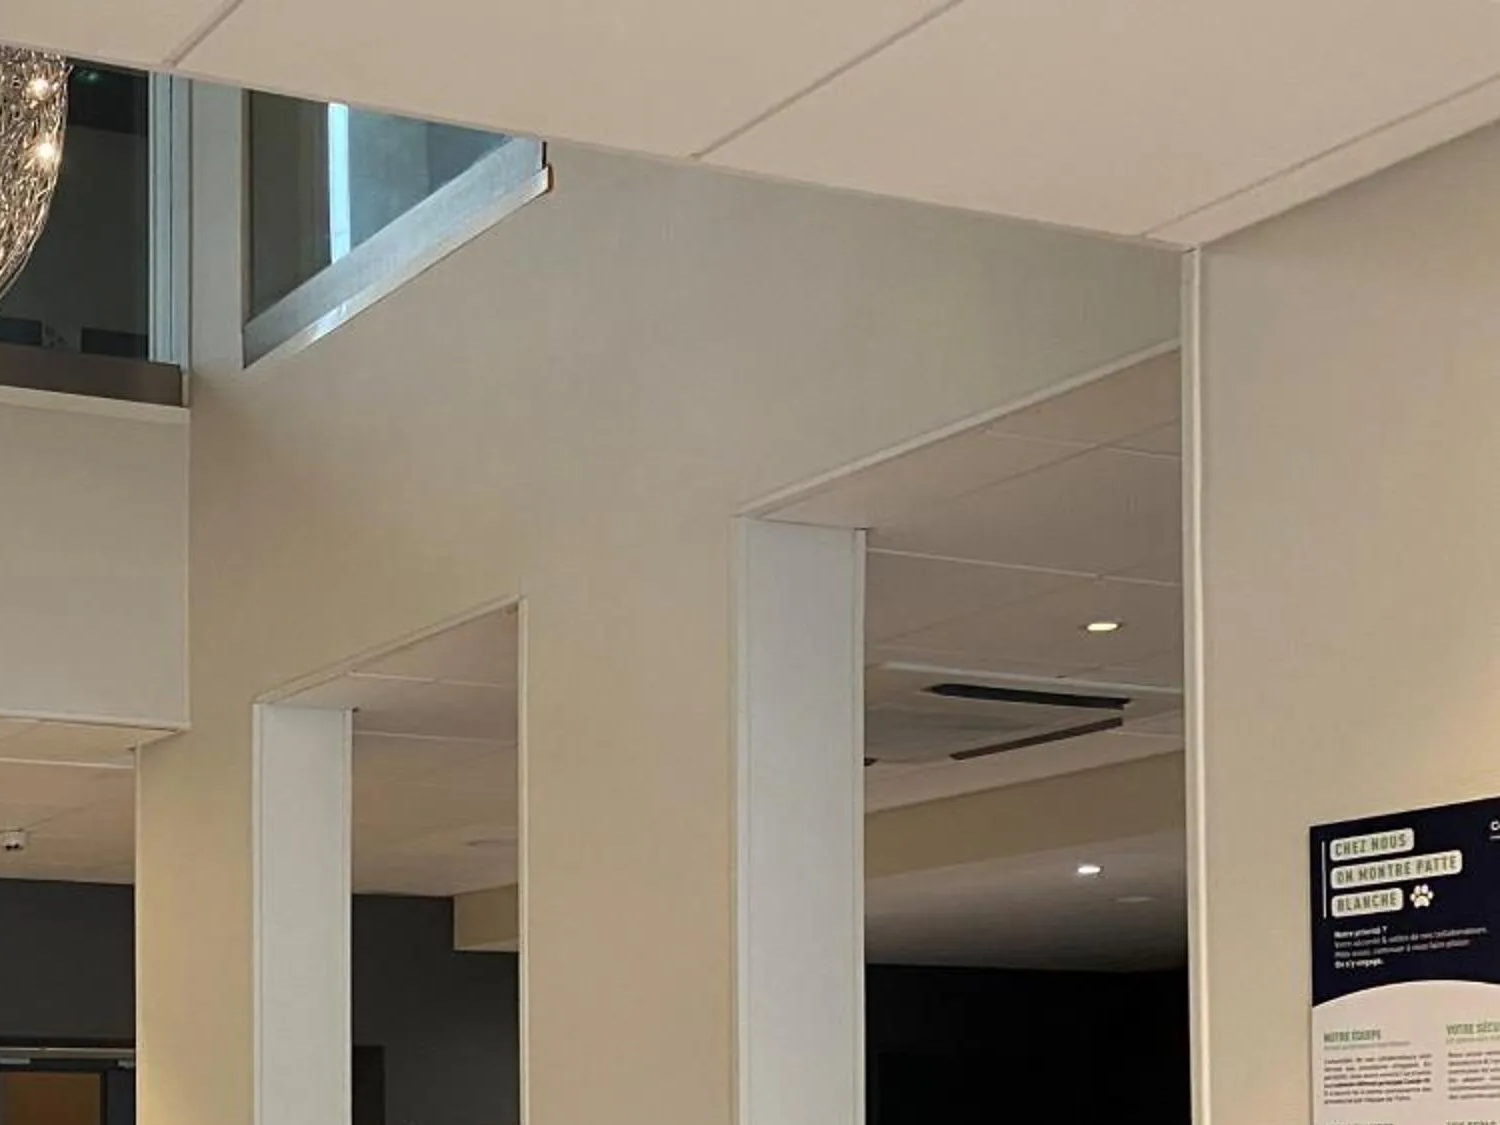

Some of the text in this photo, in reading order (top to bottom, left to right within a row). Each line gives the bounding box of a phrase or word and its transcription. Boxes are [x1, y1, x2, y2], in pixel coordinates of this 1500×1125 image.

[1334, 834, 1406, 857] CHEZ NOUS
[1335, 854, 1457, 882] ON MONTRE PATTE
[1336, 892, 1398, 912] BLANCHE
[1446, 1023, 1473, 1035] VOTRE
